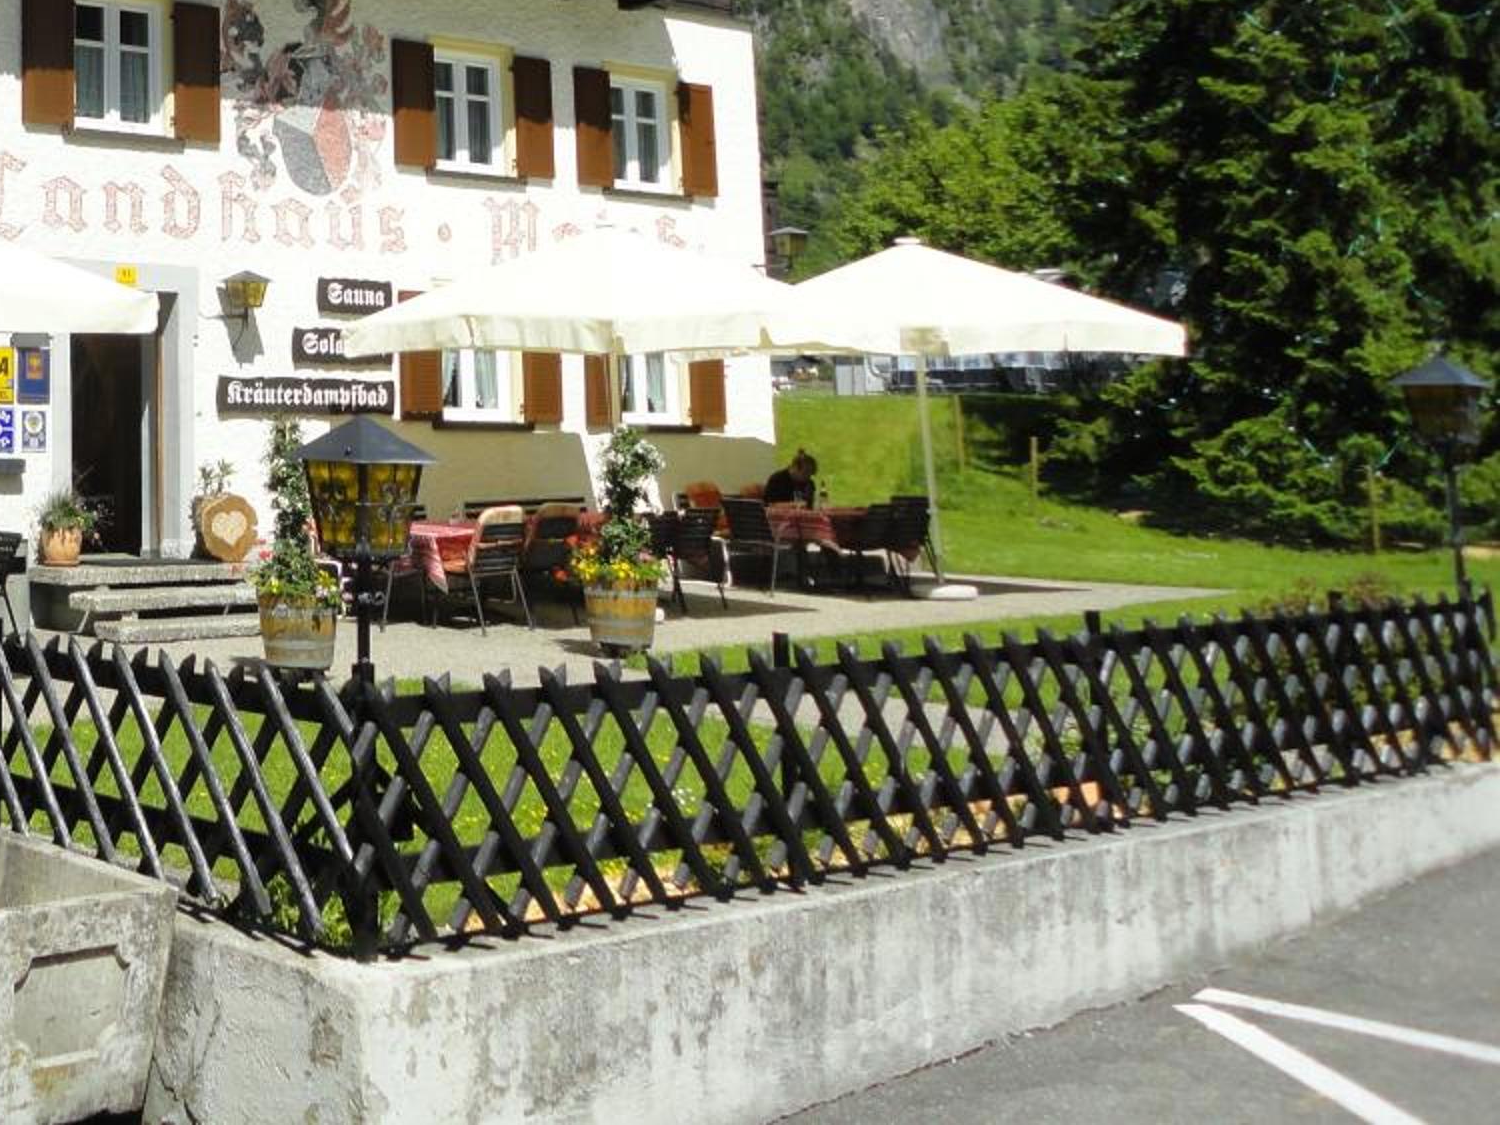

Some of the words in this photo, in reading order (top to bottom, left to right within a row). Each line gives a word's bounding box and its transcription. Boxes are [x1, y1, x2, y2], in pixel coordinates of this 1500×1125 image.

[327, 282, 386, 307] Sauna
[302, 332, 348, 355] Sola
[227, 380, 389, 410] Kräuterdampfbad
